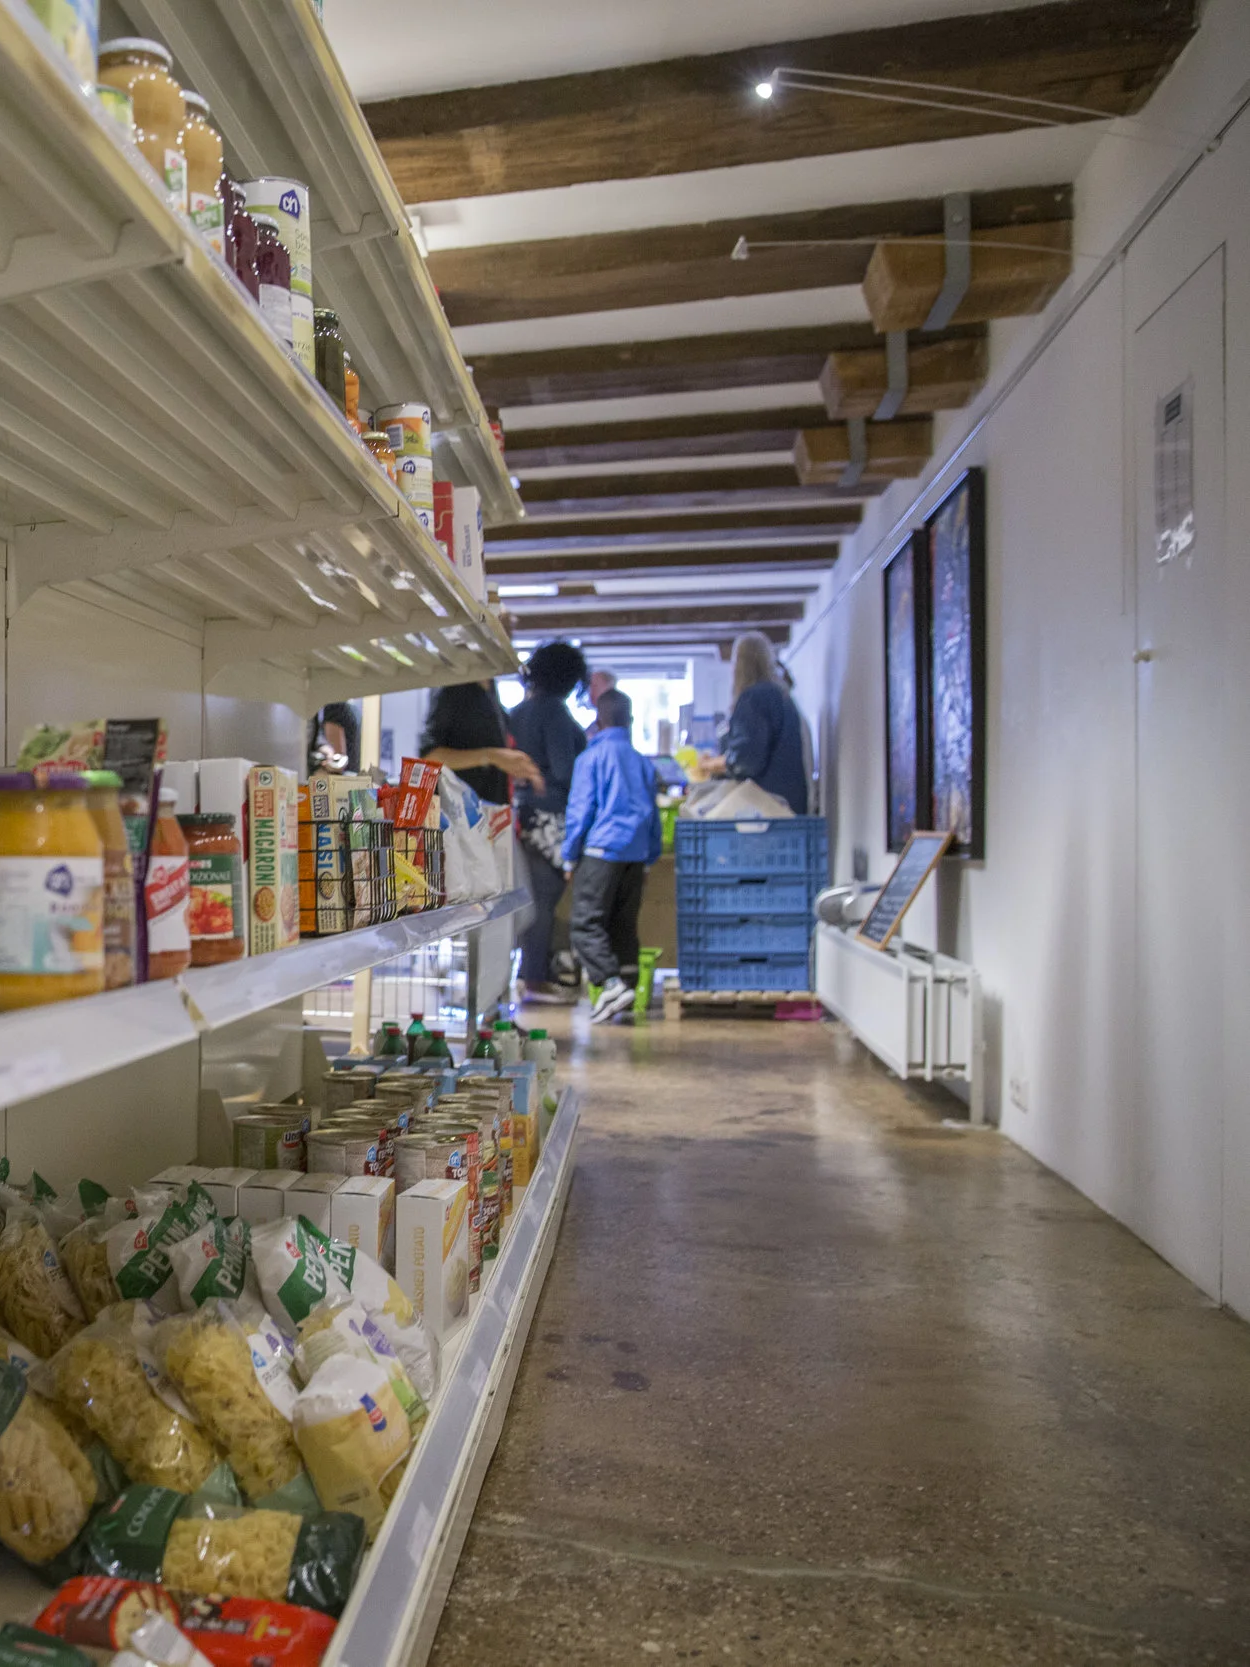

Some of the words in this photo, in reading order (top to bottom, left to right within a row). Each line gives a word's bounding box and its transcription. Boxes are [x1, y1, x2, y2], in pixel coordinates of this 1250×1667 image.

[254, 819, 276, 886] MACARONI
[317, 823, 334, 869] NASI
[412, 1226, 425, 1267] POTATO
